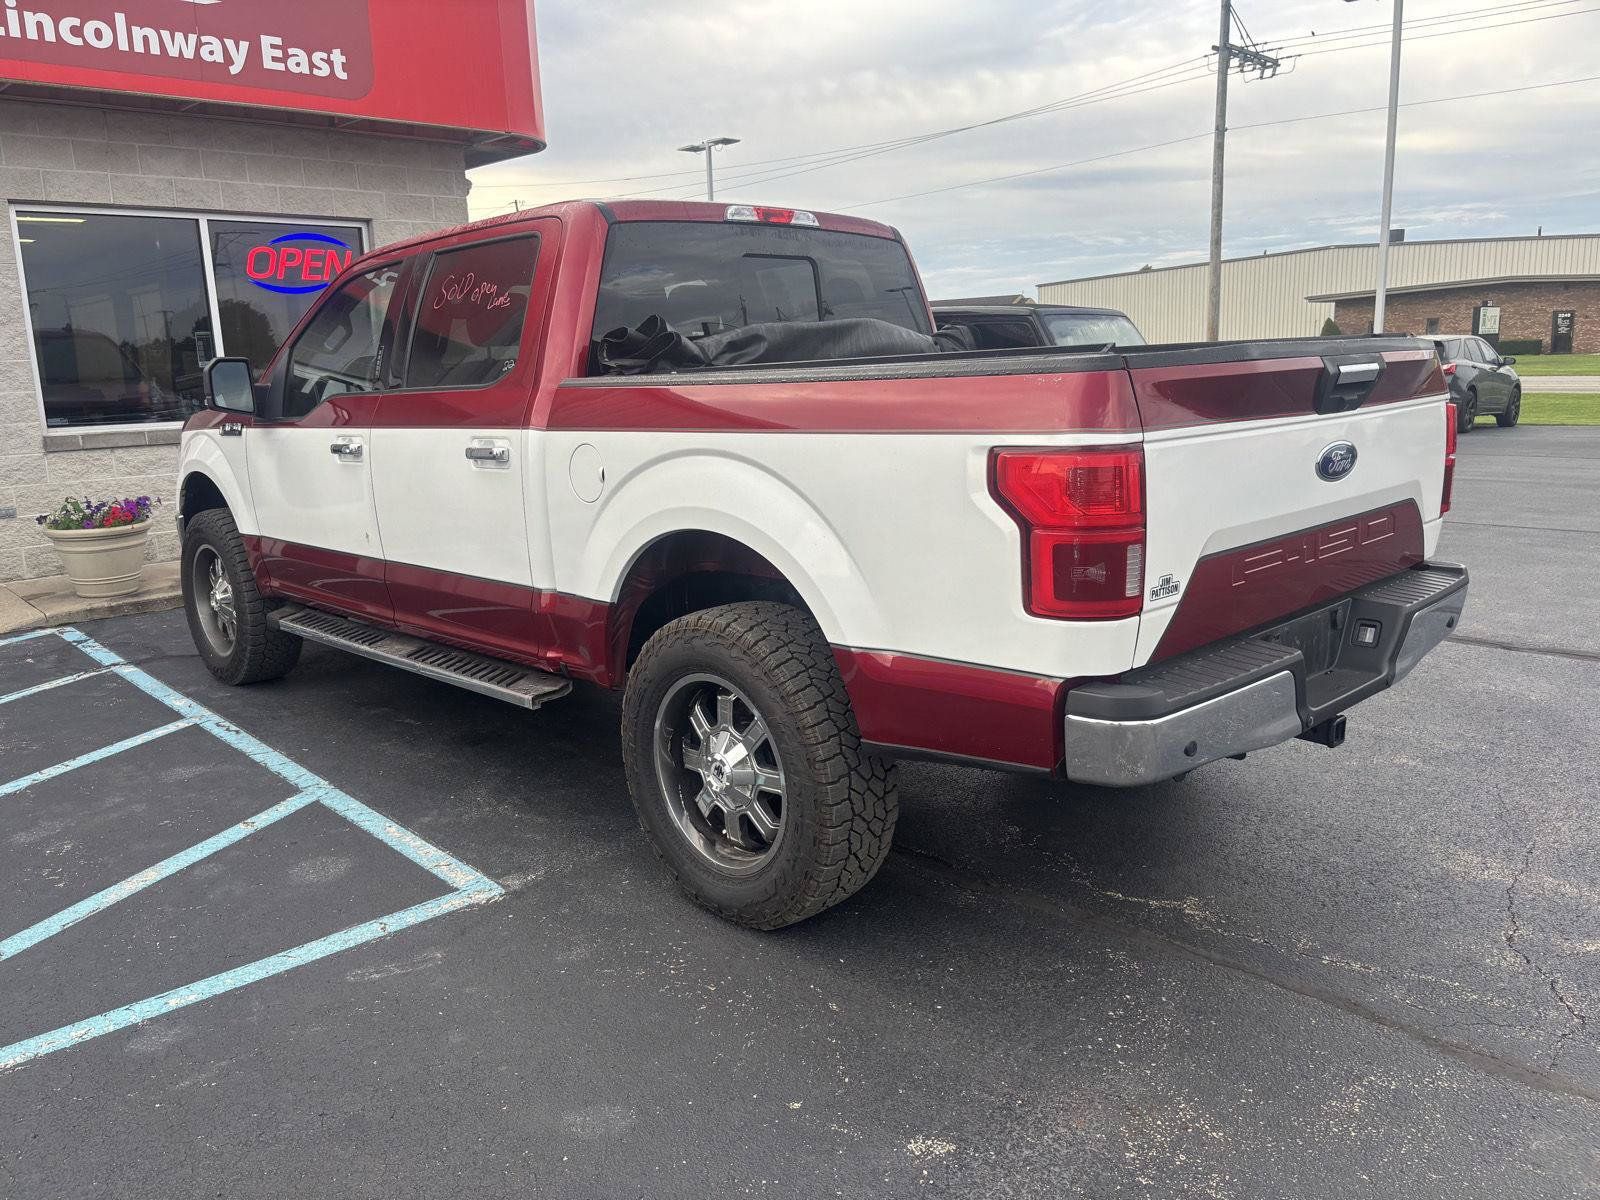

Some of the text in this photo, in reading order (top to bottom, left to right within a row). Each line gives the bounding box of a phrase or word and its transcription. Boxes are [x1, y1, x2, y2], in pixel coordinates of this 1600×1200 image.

[0, 0, 348, 81] incolnway East
[246, 245, 352, 282] OPEN
[1151, 583, 1179, 600] PATTISON
[1160, 576, 1172, 588] JIM
